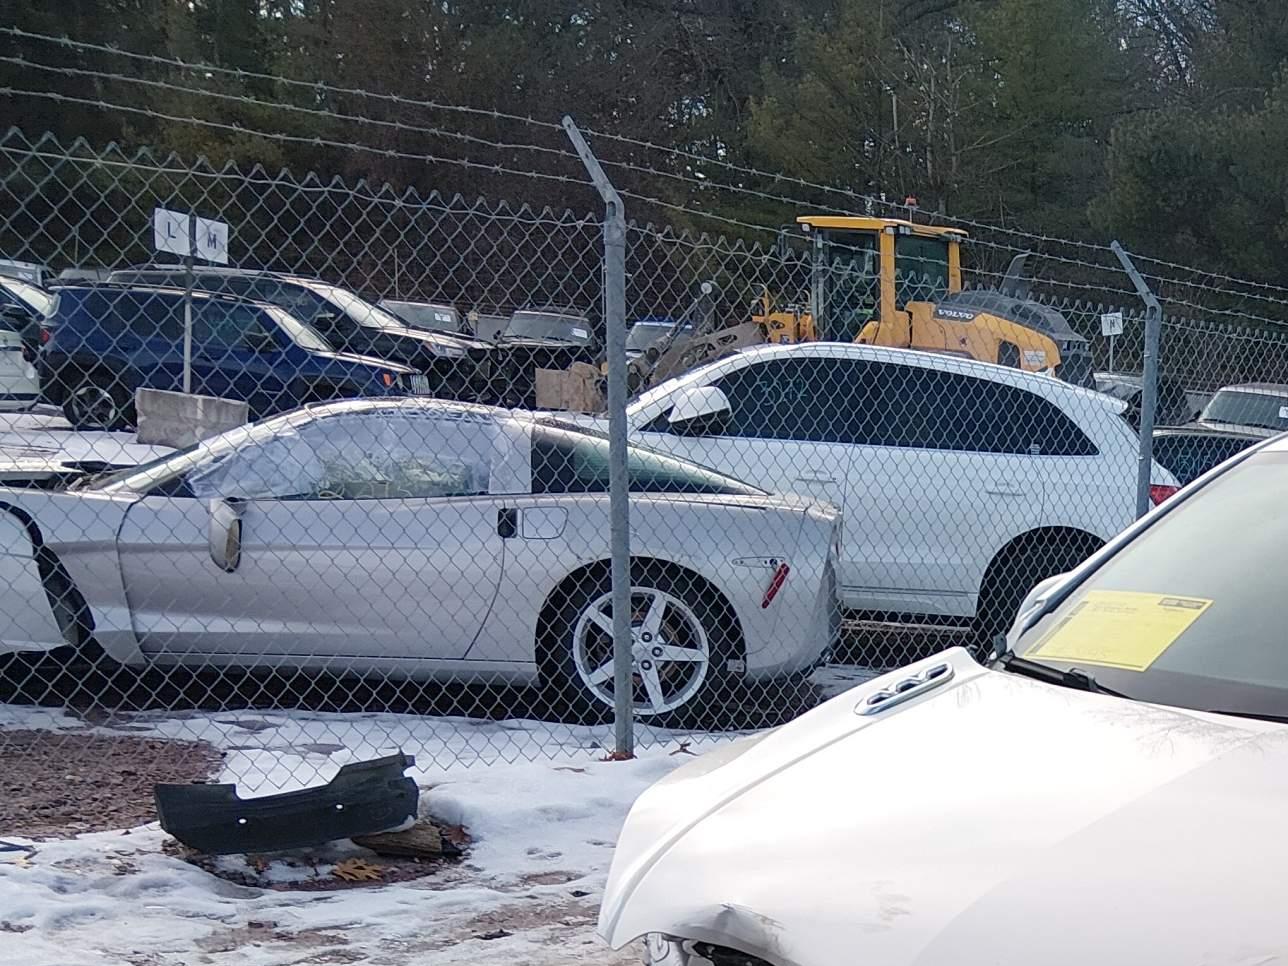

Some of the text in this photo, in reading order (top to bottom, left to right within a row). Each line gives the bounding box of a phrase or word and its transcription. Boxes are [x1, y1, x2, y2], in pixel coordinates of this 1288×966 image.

[167, 221, 177, 239] L
[207, 231, 217, 250] M
[938, 308, 974, 320] VOLVO
